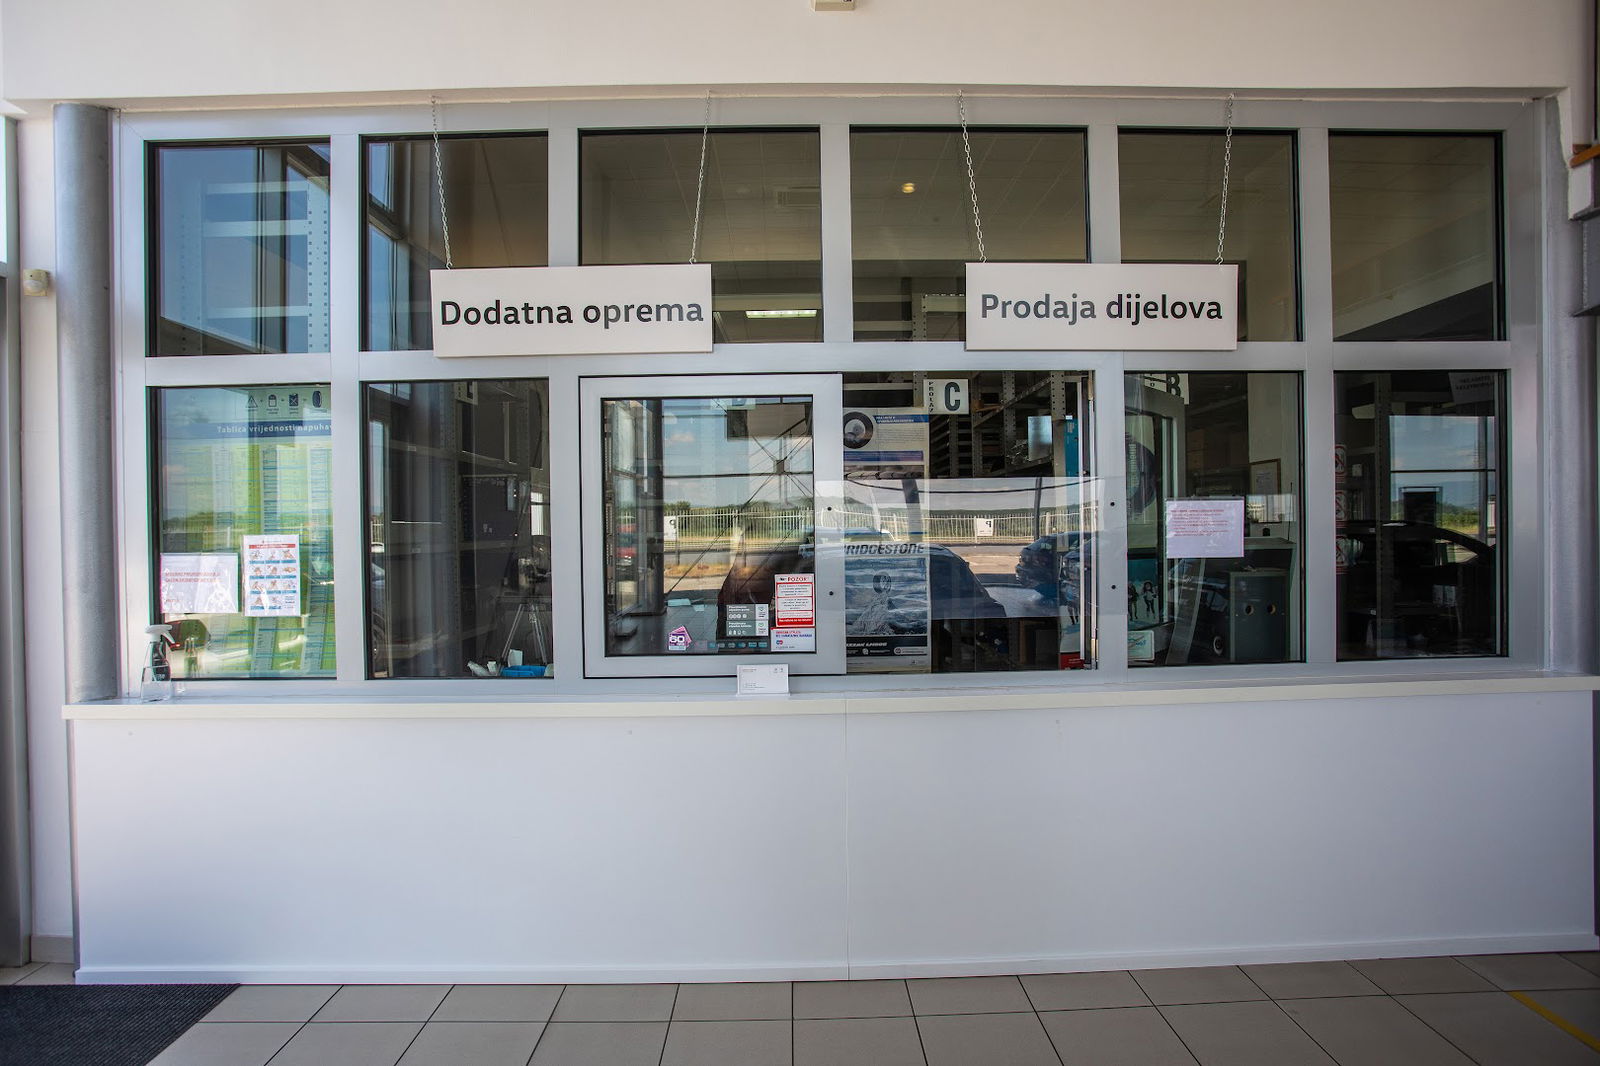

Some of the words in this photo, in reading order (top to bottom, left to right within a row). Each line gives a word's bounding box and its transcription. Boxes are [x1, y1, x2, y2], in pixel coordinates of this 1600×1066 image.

[441, 300, 573, 326] Dodatna
[583, 302, 704, 329] oprema
[981, 293, 1096, 325] Prodaja
[1106, 293, 1223, 325] dijelova
[944, 381, 961, 411] C
[217, 425, 247, 434] Tablica
[249, 424, 297, 434] vrijednosti
[844, 543, 924, 555] RIDGESTONE
